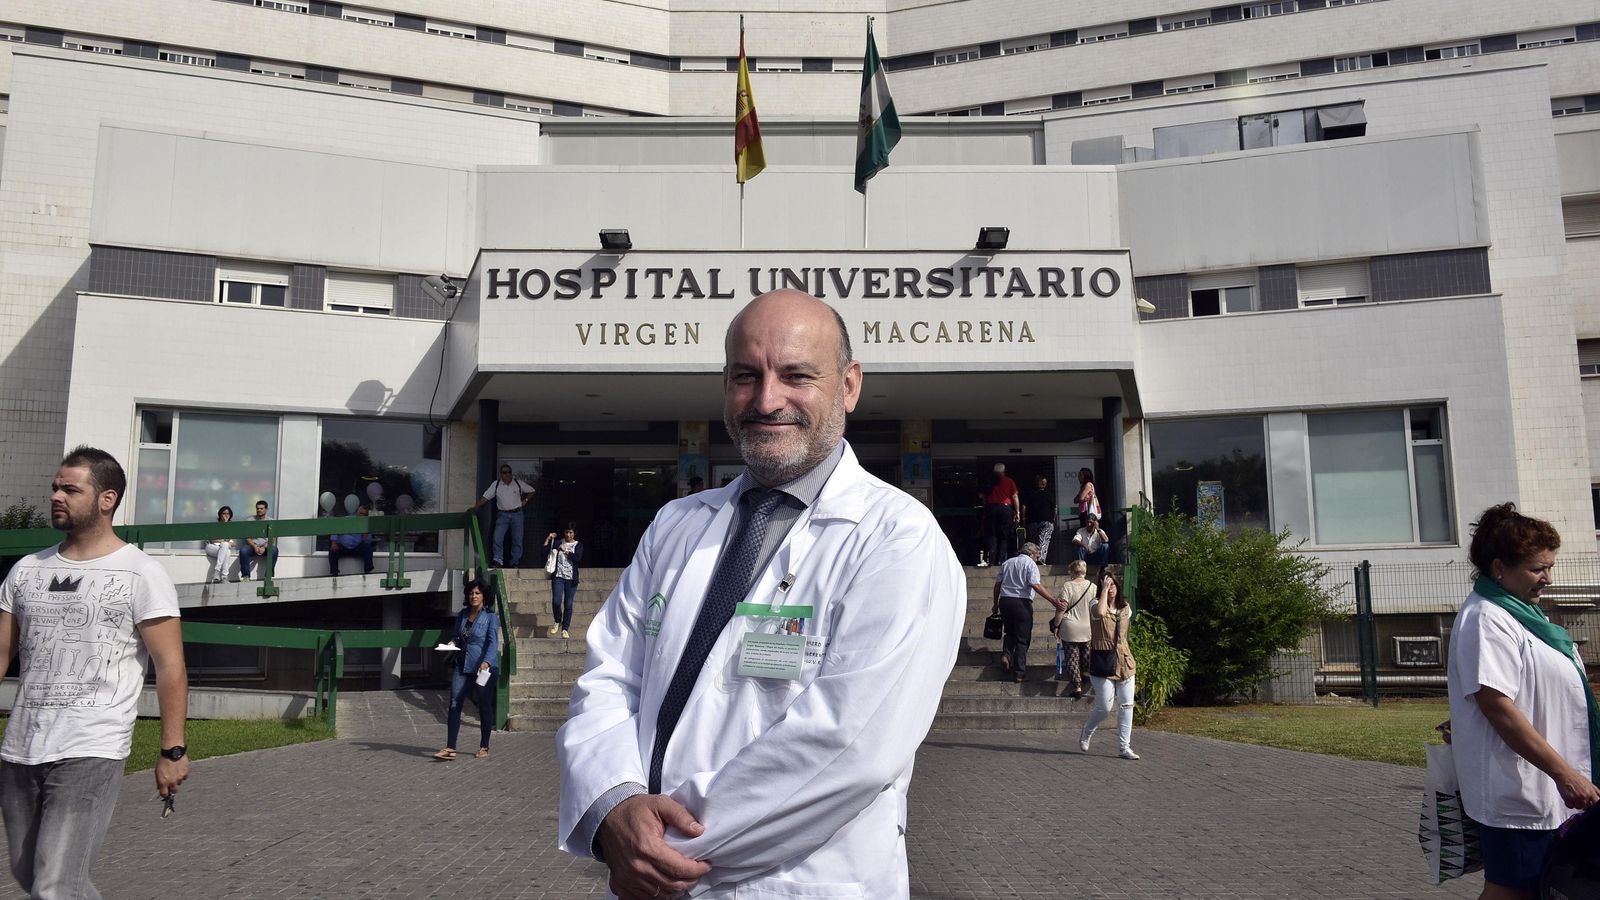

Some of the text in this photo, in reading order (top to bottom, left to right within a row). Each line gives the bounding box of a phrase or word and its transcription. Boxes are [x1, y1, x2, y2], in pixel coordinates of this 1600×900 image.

[486, 266, 1121, 300] HOSPITAL UNIVERSITARIO
[575, 320, 1036, 346] VIRGEN MACARENA
[28, 591, 83, 602] TEST PRESSING
[27, 605, 85, 615] VERSION ONE
[66, 617, 83, 625] ONE
